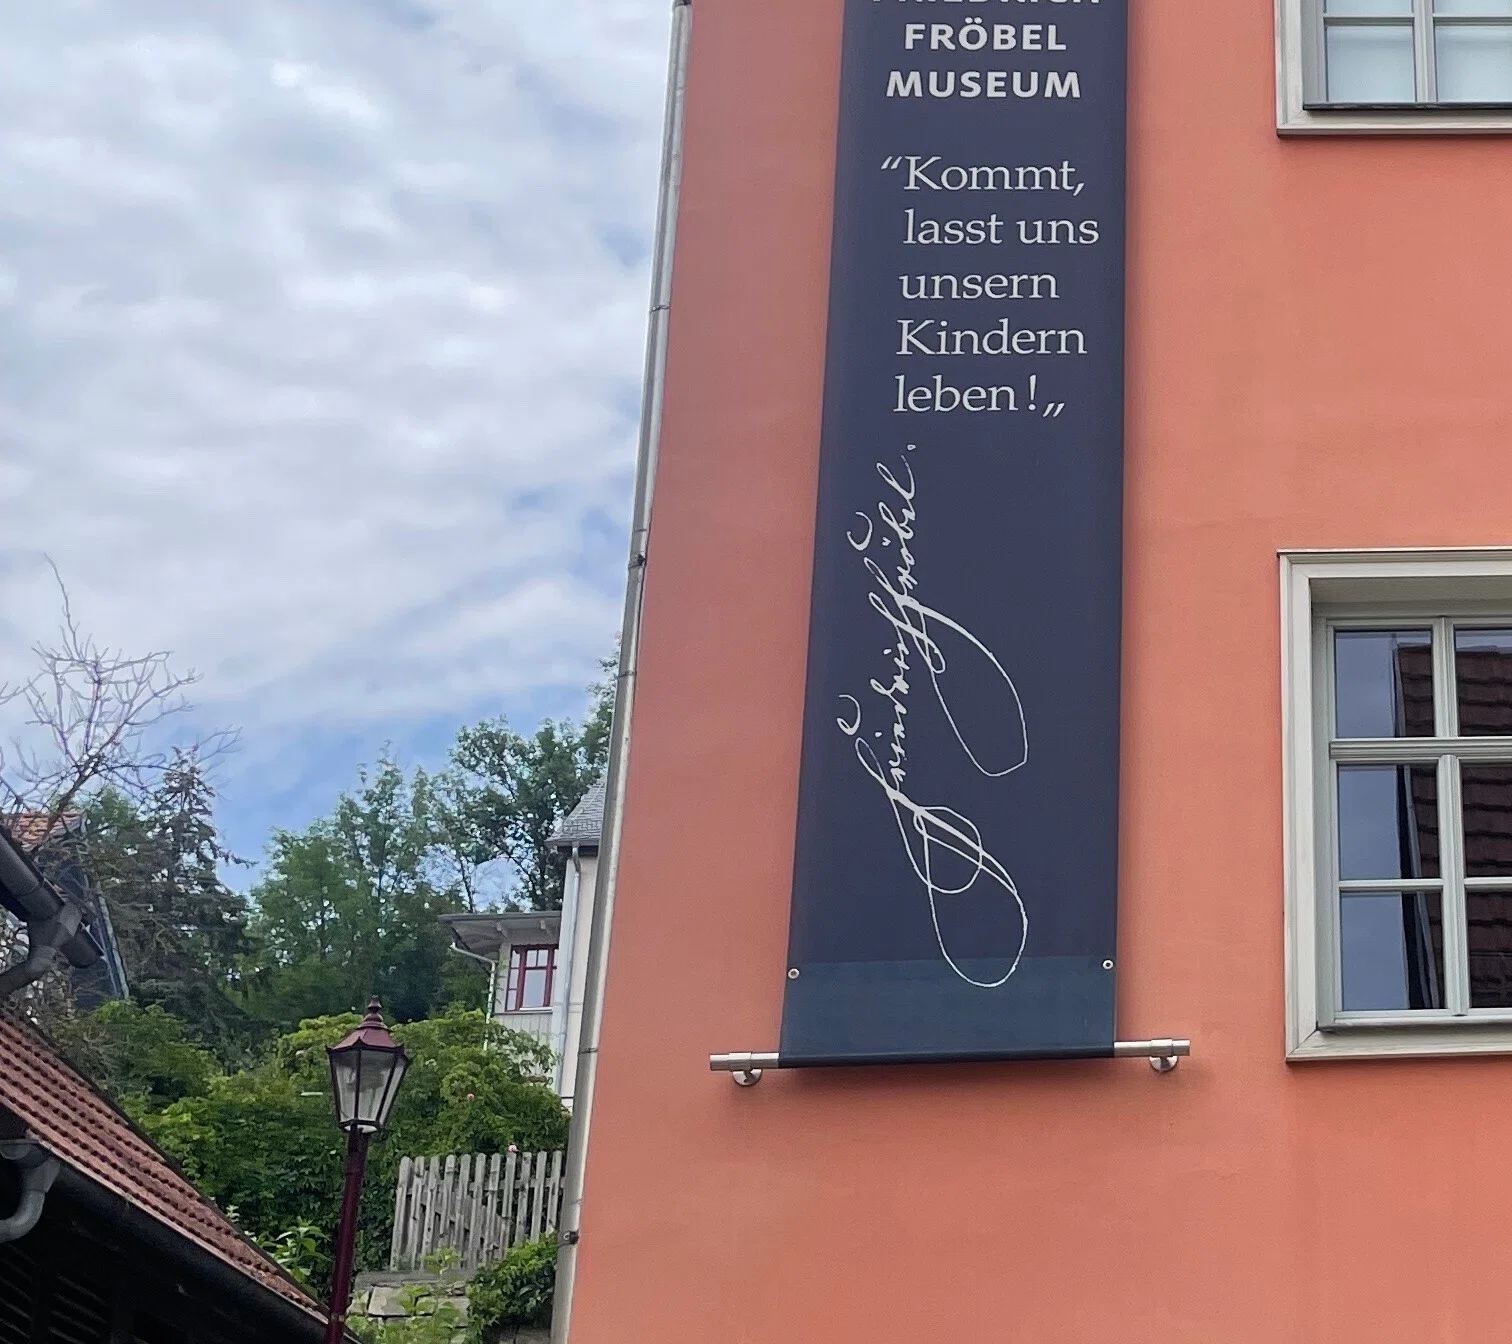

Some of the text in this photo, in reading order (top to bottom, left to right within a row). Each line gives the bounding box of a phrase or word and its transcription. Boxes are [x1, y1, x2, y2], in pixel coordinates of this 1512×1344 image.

[904, 16, 1067, 51] FRÖBEL
[886, 71, 1081, 98] MUSEUM
[903, 209, 1099, 245] lasst uns
[899, 274, 1059, 299] unsern
[896, 318, 1087, 355] Kindern
